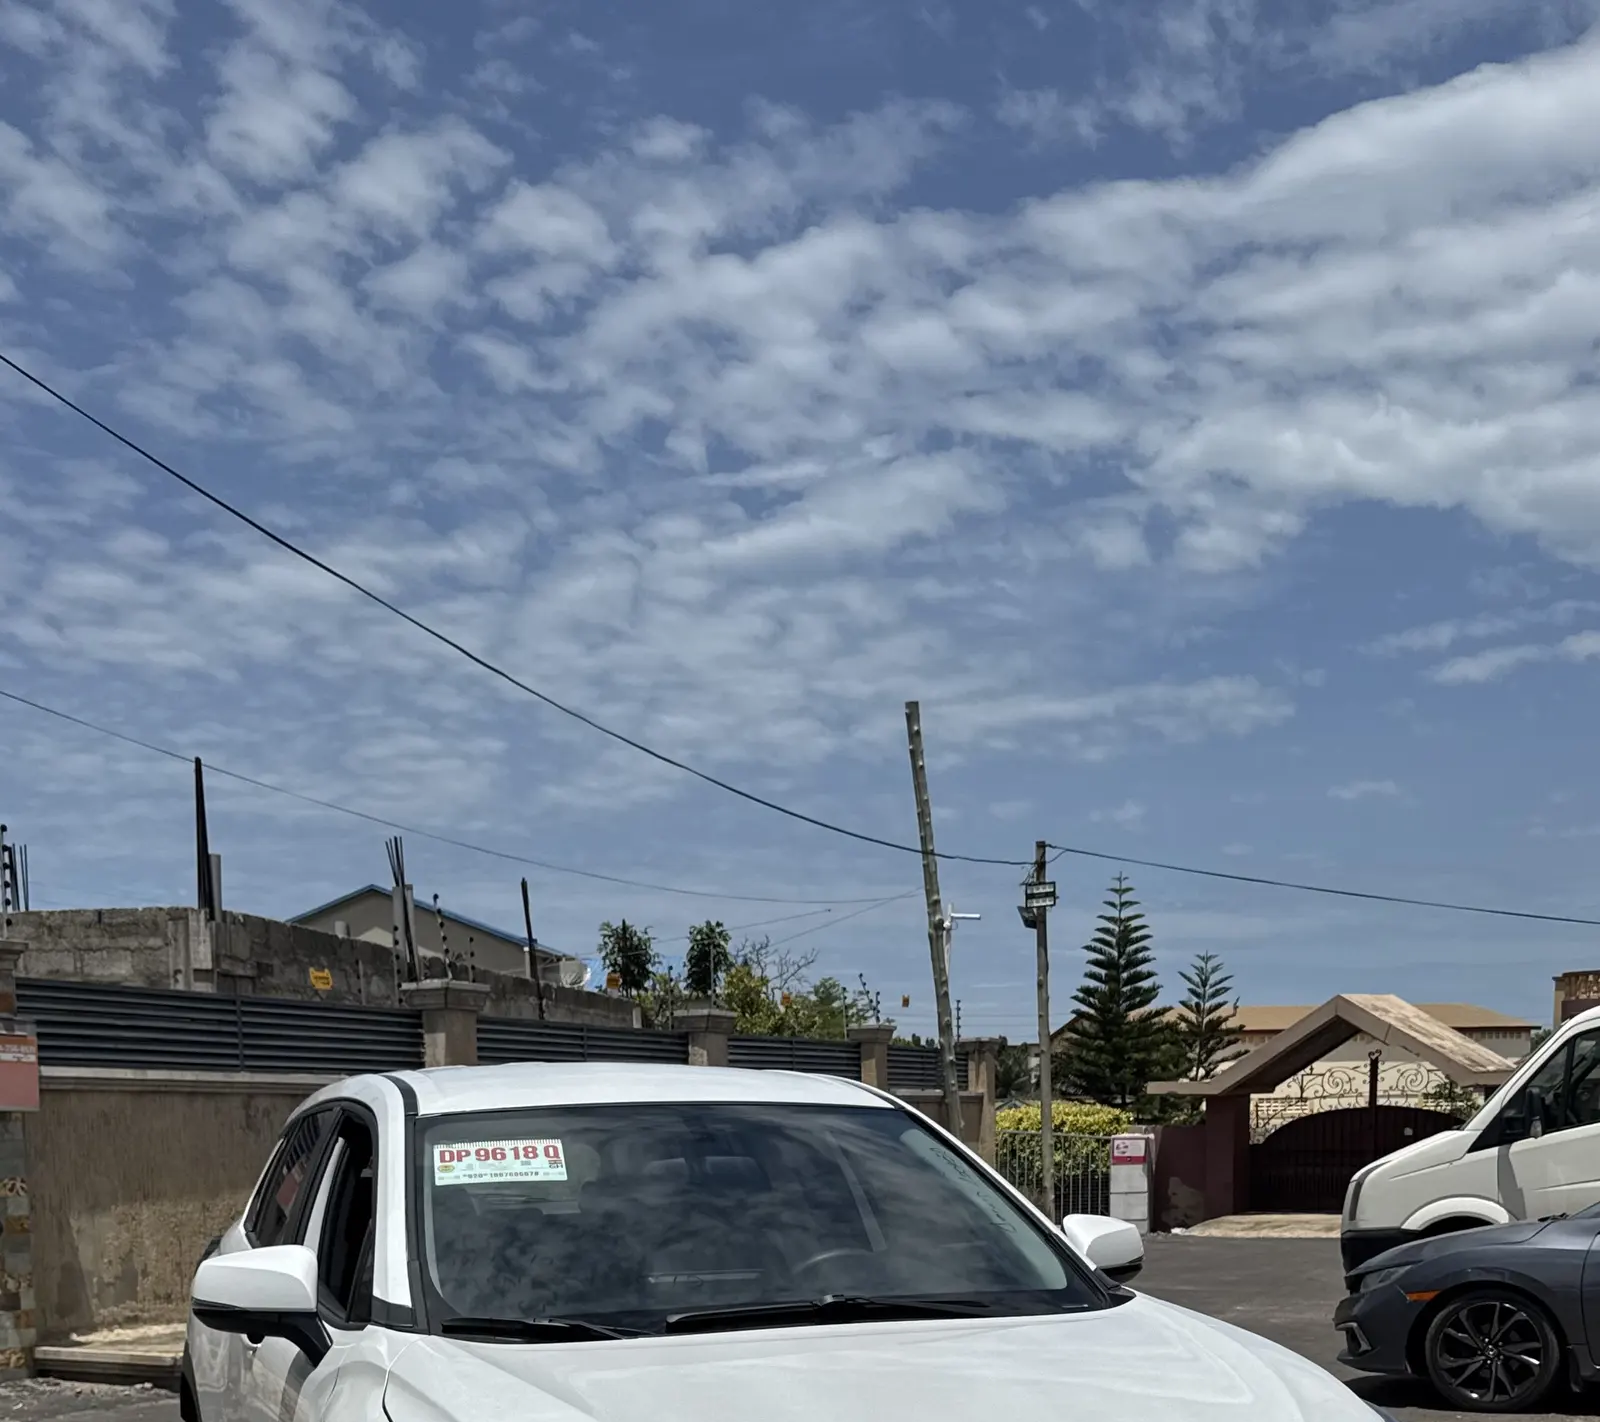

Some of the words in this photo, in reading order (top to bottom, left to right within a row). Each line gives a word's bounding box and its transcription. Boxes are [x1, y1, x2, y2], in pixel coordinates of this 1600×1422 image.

[439, 1149, 471, 1163] DP
[475, 1146, 539, 1161] 9618
[544, 1145, 561, 1159] Q
